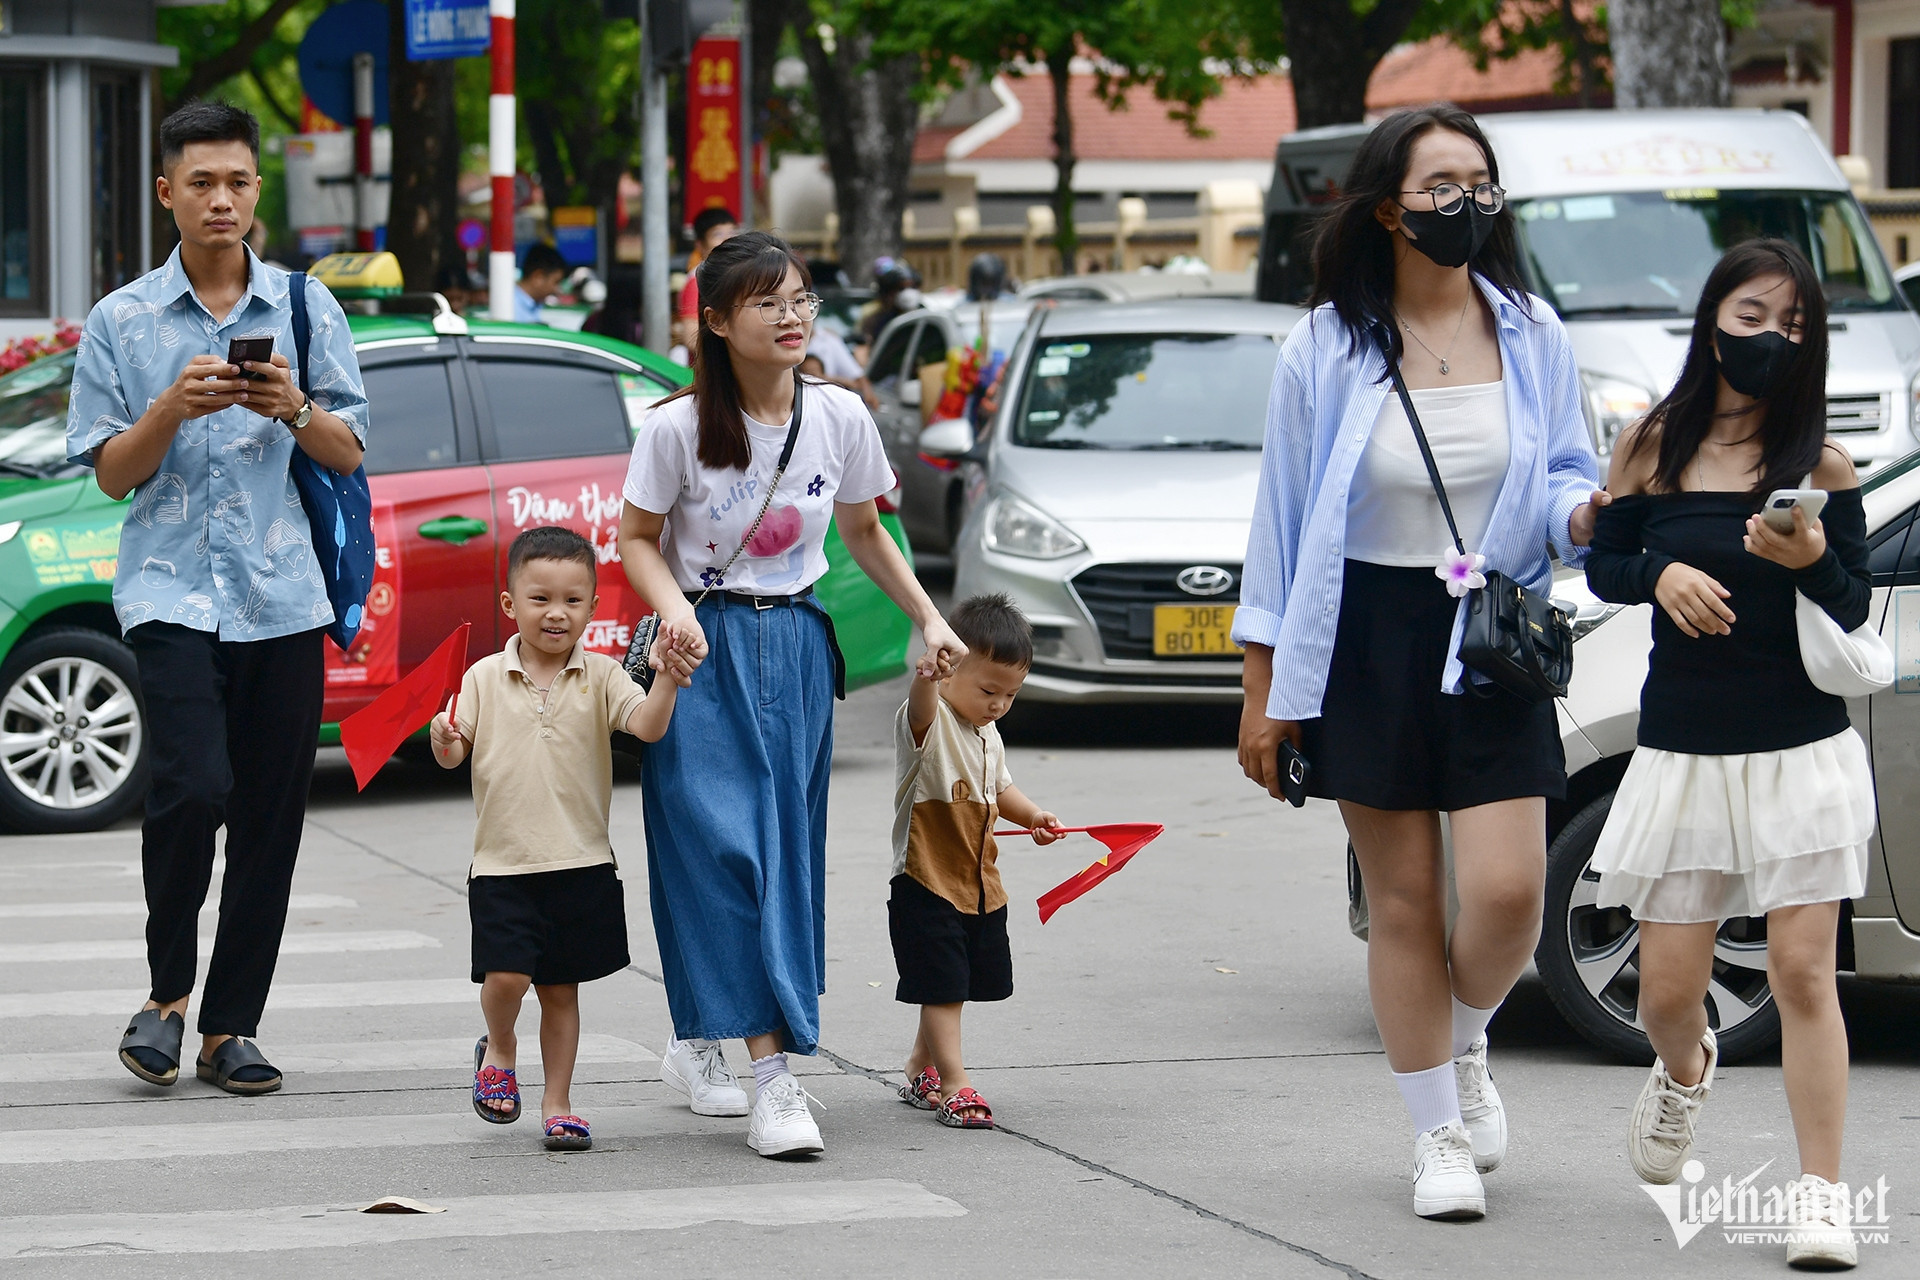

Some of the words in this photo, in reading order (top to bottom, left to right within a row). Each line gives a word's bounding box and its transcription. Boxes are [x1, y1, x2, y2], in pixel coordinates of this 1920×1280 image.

[1562, 140, 1775, 173] LUXURY
[506, 486, 576, 527] Đậm
[577, 481, 624, 527] thơ
[710, 480, 758, 521] tulip
[1184, 606, 1224, 629] 30E
[1166, 631, 1227, 651] 801.1
